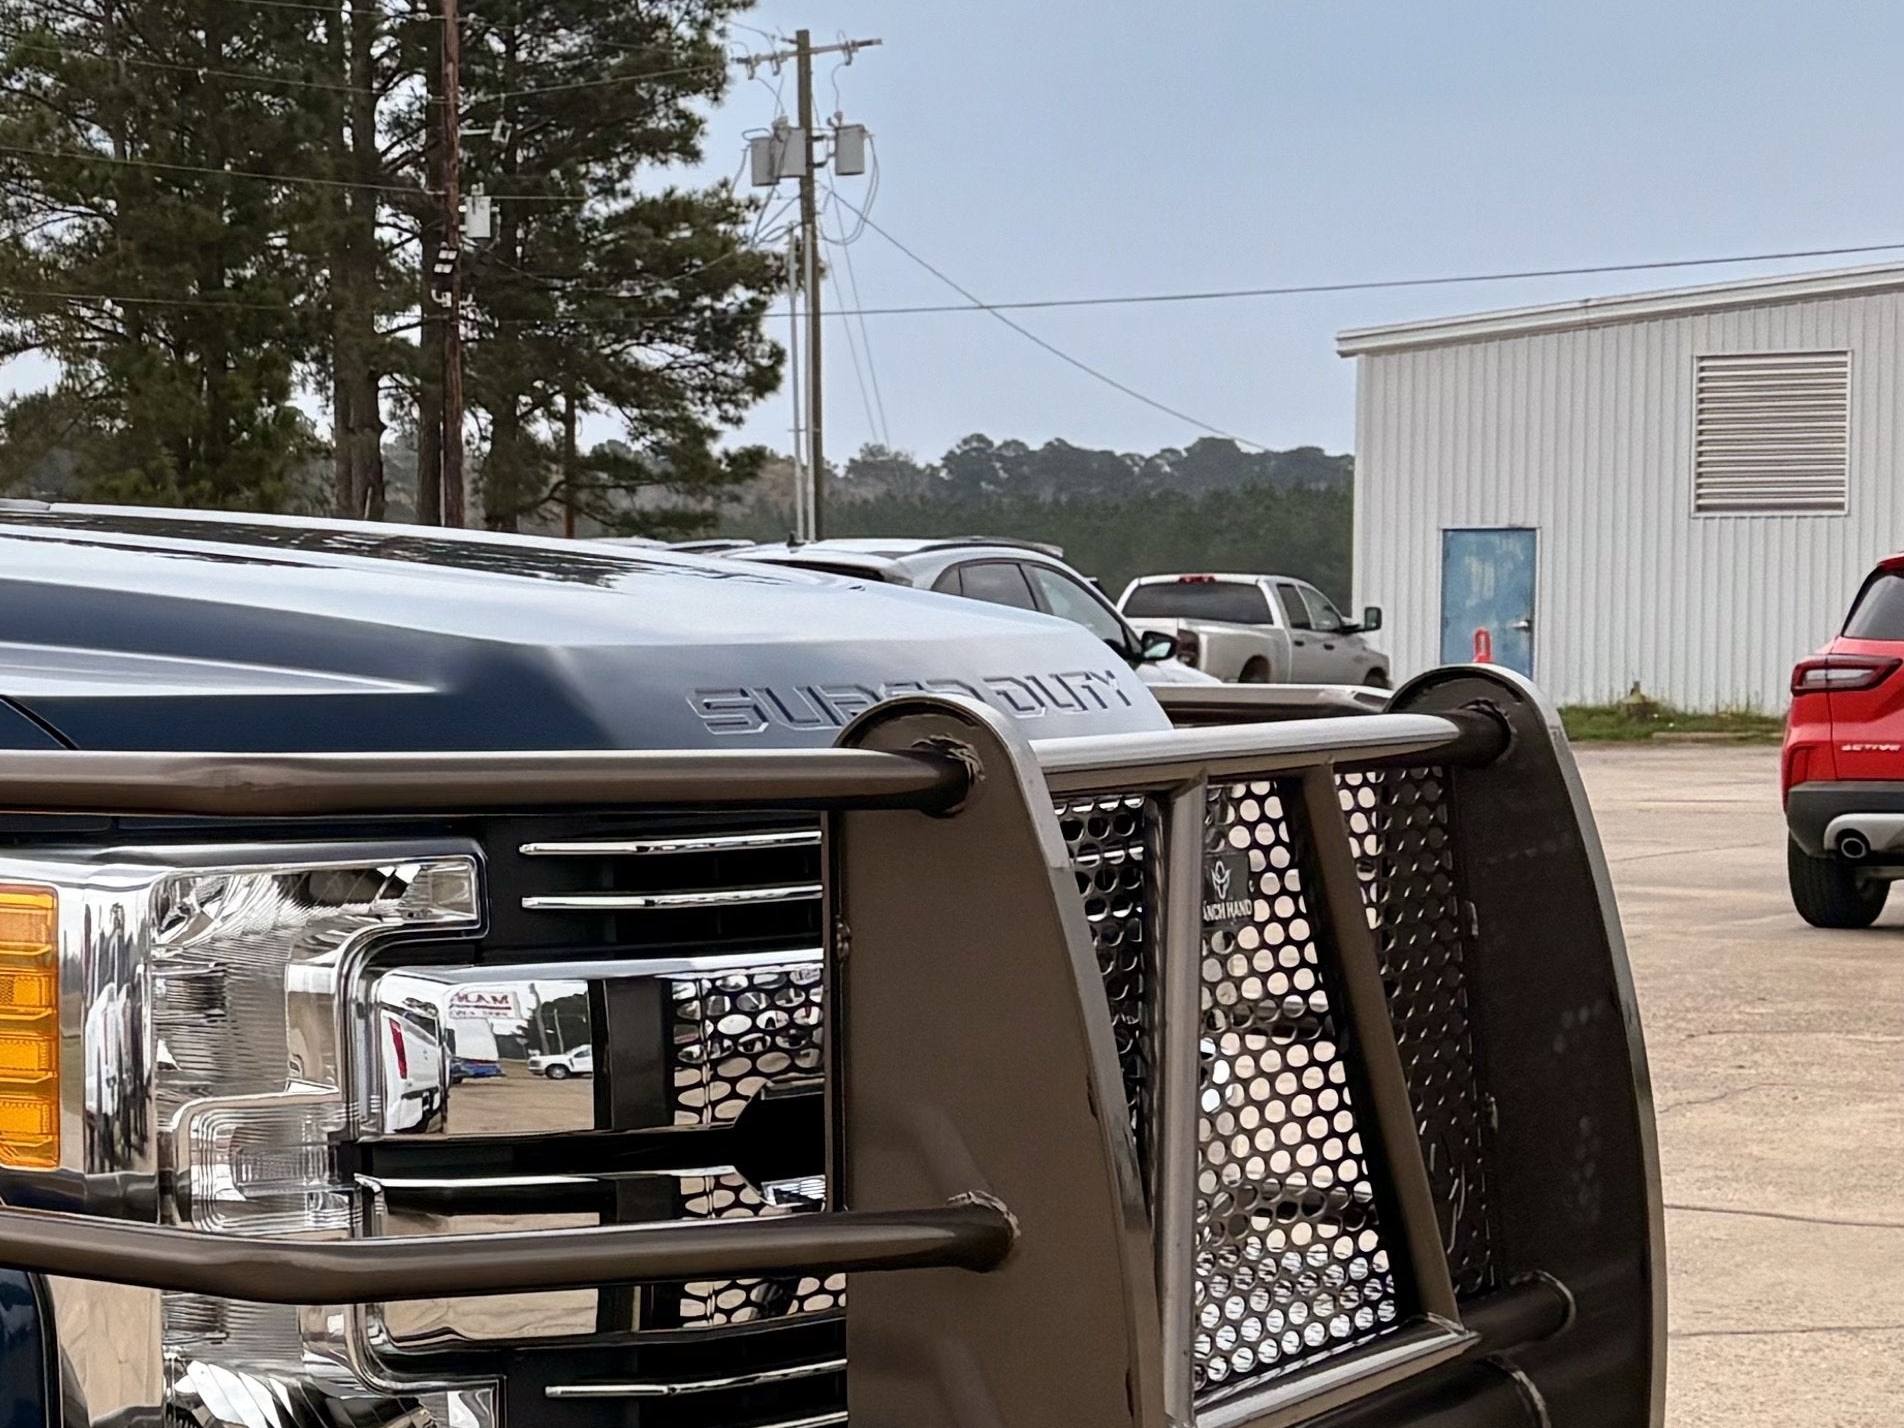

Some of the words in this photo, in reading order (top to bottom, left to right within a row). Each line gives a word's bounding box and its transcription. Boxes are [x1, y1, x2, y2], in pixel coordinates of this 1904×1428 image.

[686, 679, 982, 735] SUP
[984, 669, 1133, 720] DUTY
[1226, 898, 1253, 919] HAND
